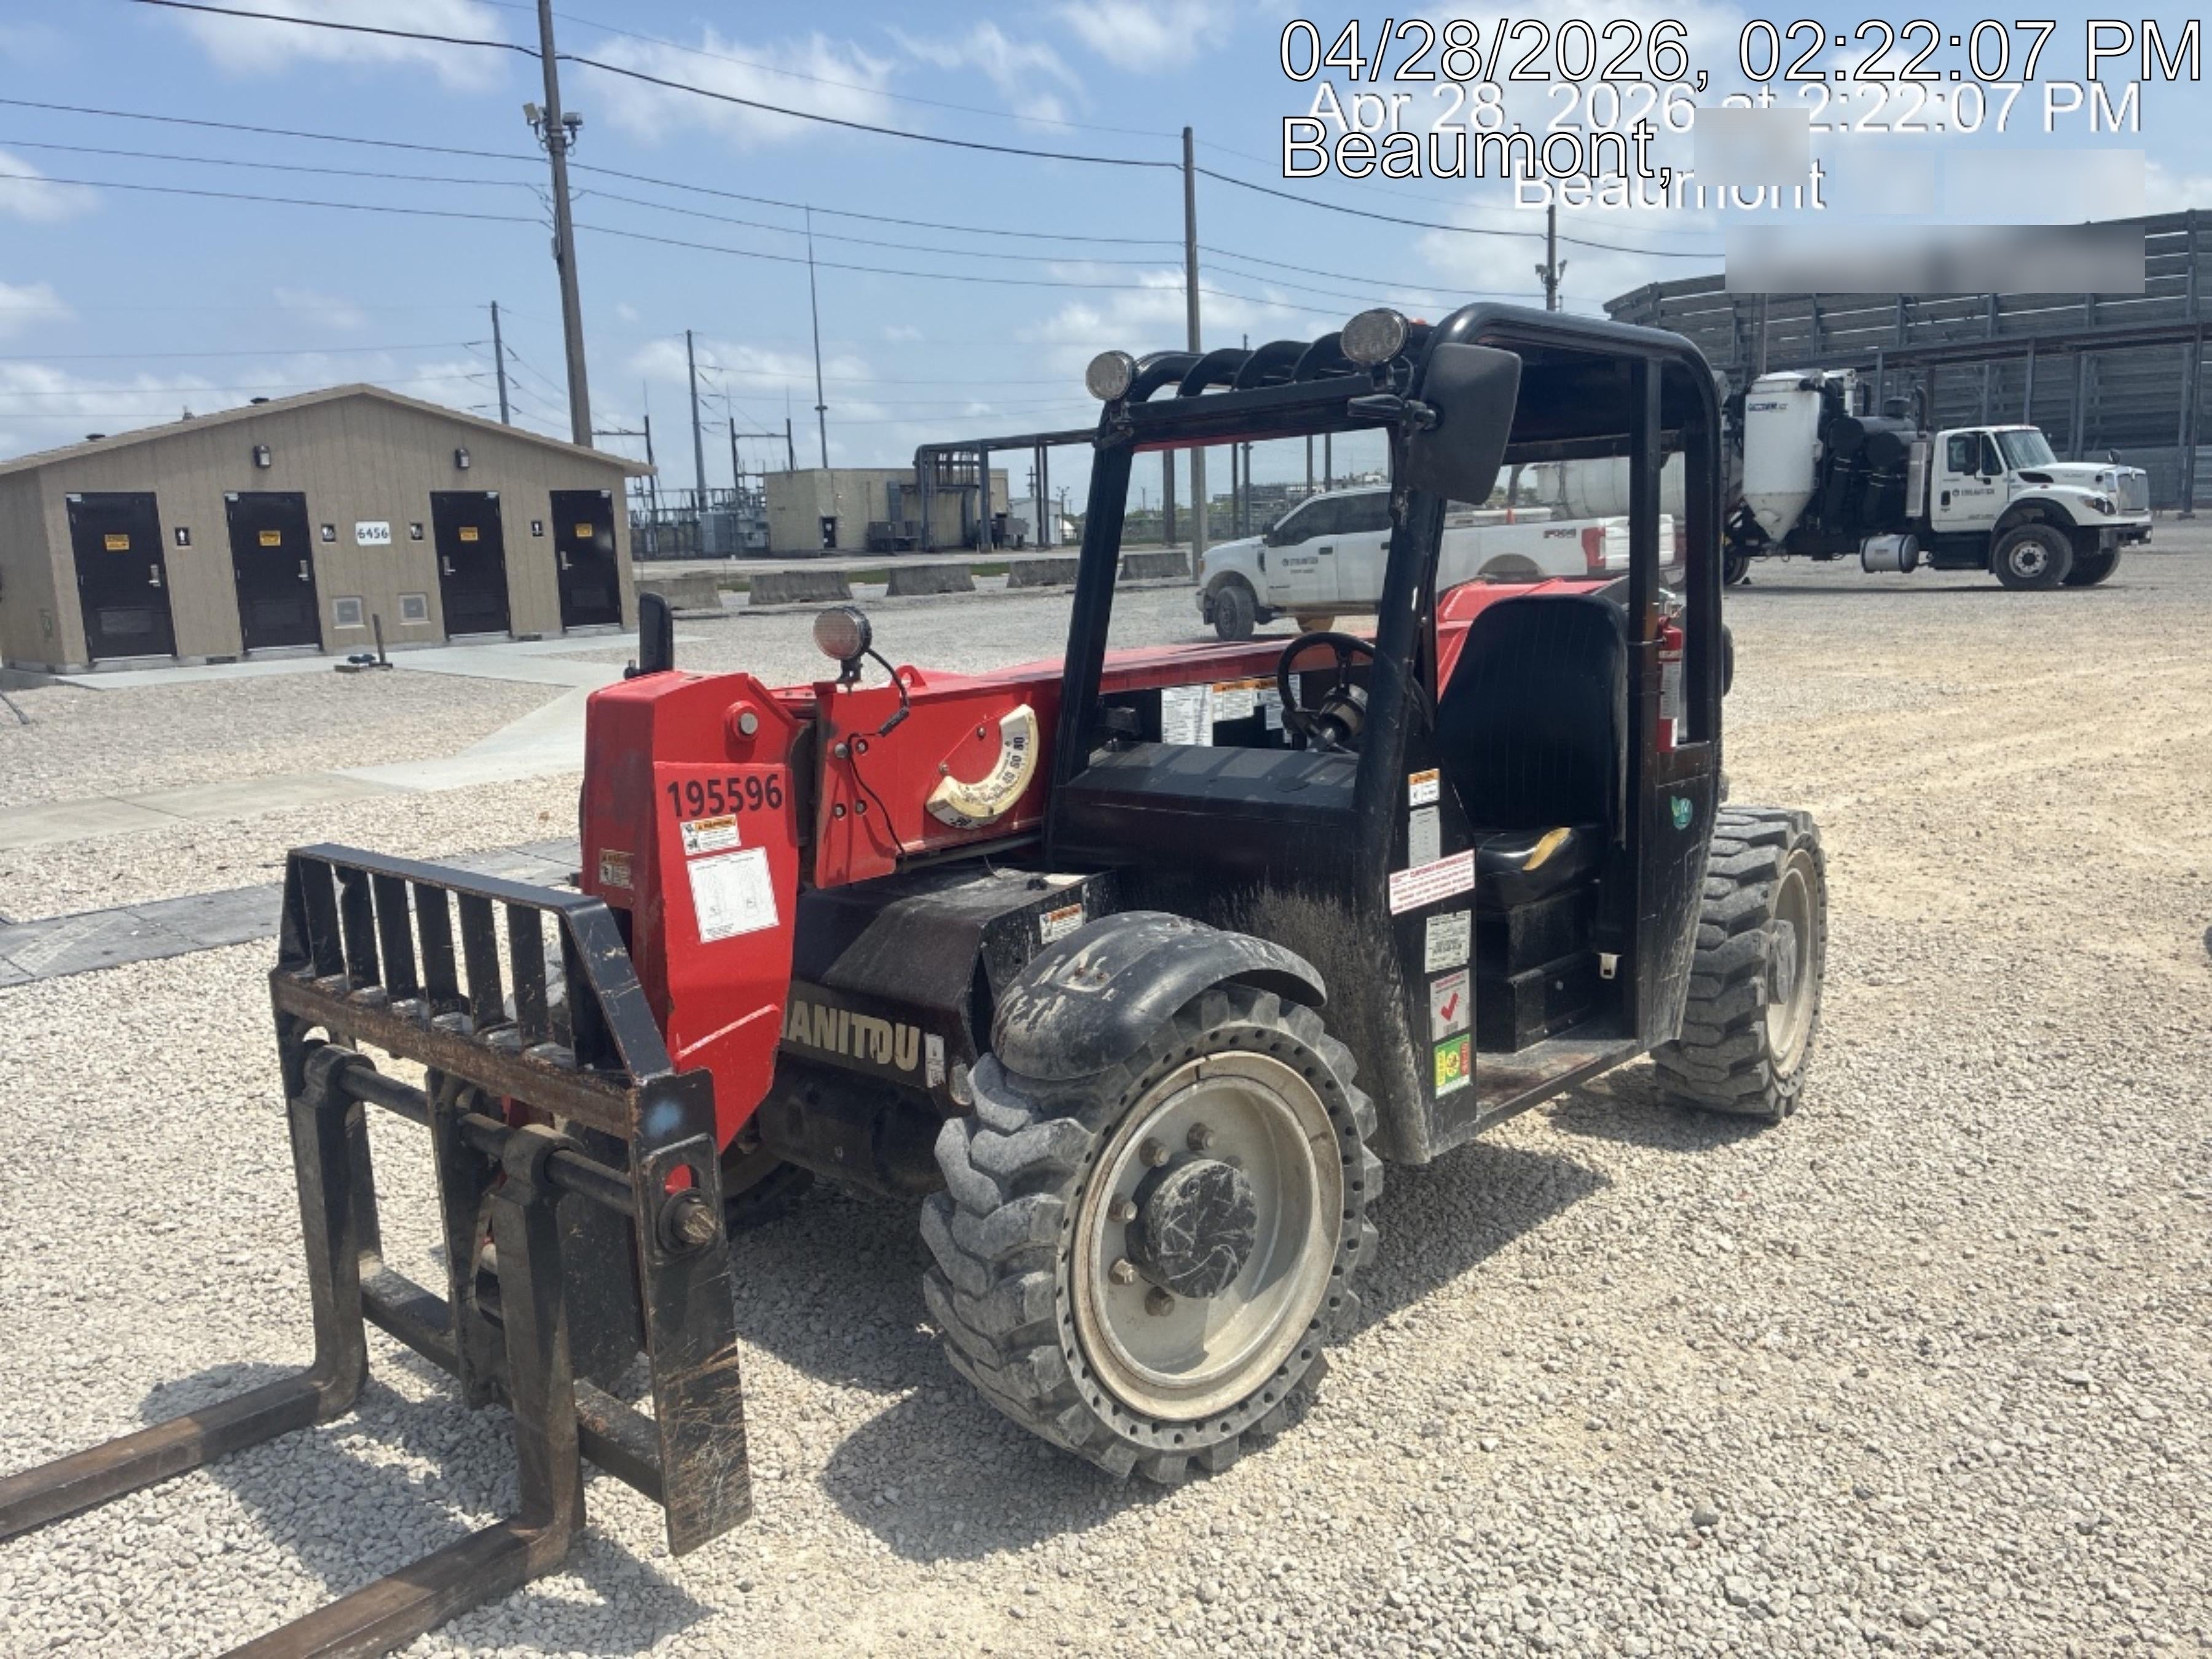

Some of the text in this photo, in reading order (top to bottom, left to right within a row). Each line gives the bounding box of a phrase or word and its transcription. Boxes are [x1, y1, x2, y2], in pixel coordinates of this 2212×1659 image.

[358, 527, 388, 539] 6456
[667, 774, 782, 818] 195596
[780, 1000, 920, 1072] ANITOU
